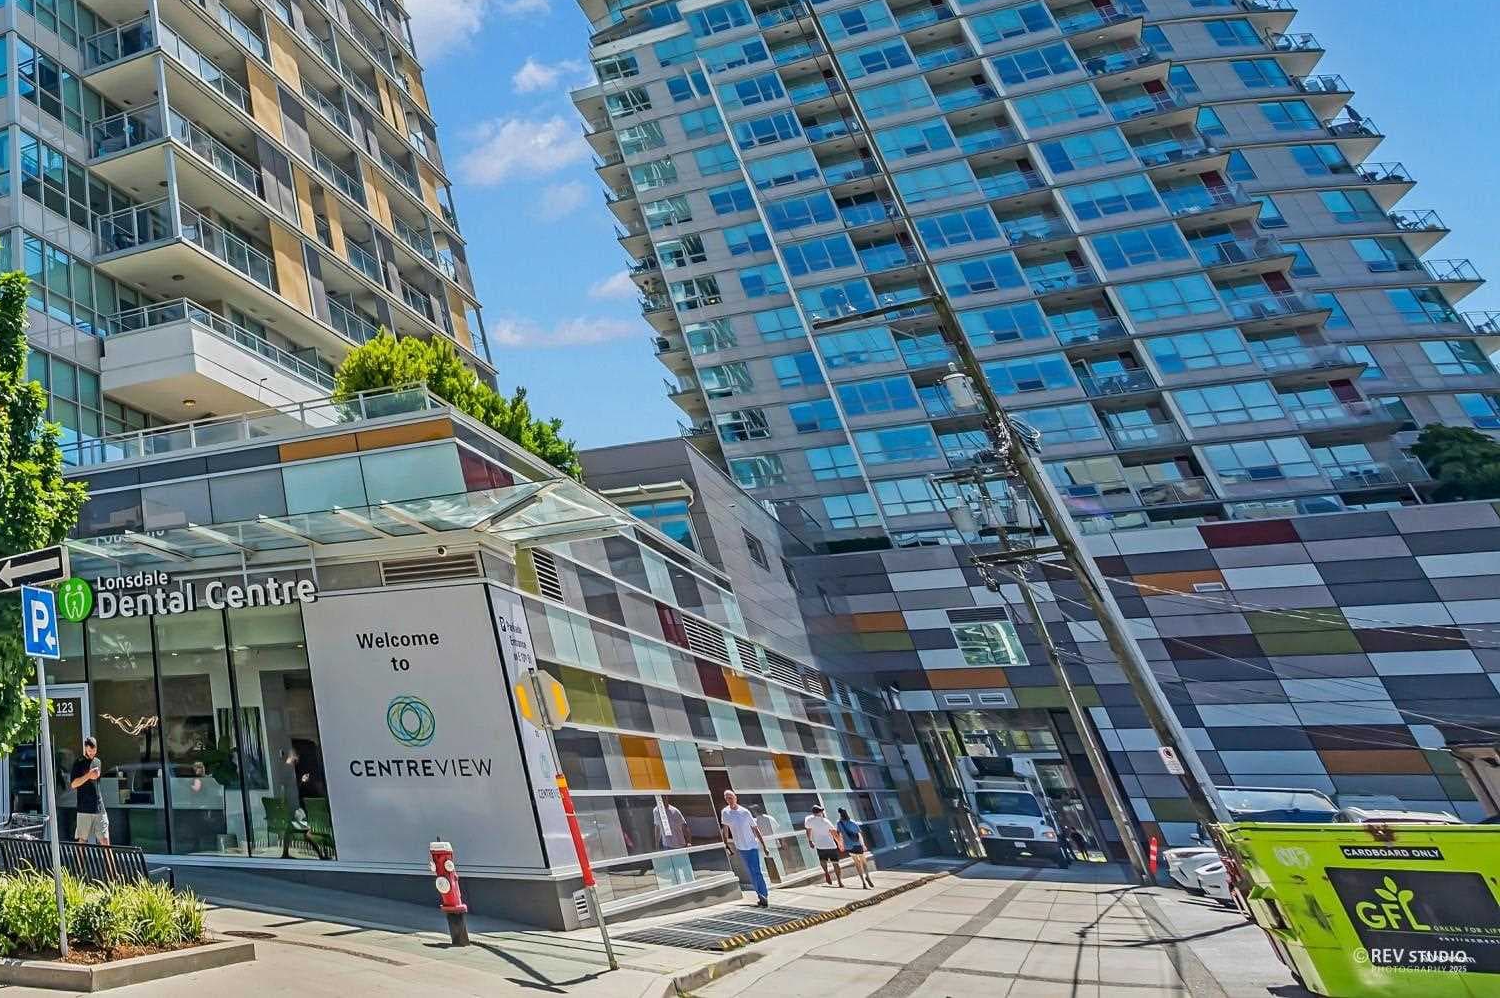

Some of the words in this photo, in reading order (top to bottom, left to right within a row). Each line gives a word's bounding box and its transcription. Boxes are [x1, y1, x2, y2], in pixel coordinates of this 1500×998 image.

[97, 570, 168, 590] Lonsdale
[98, 583, 194, 618] Dental
[205, 577, 316, 609] Centre
[30, 599, 49, 643] P
[356, 632, 440, 649] Welcome
[390, 657, 410, 671] to
[56, 702, 74, 714] 123
[349, 758, 492, 777] CENTREVIEW
[1343, 848, 1409, 858] CARDBOARD
[1412, 849, 1439, 859] ONLY
[1355, 890, 1431, 930] GFL
